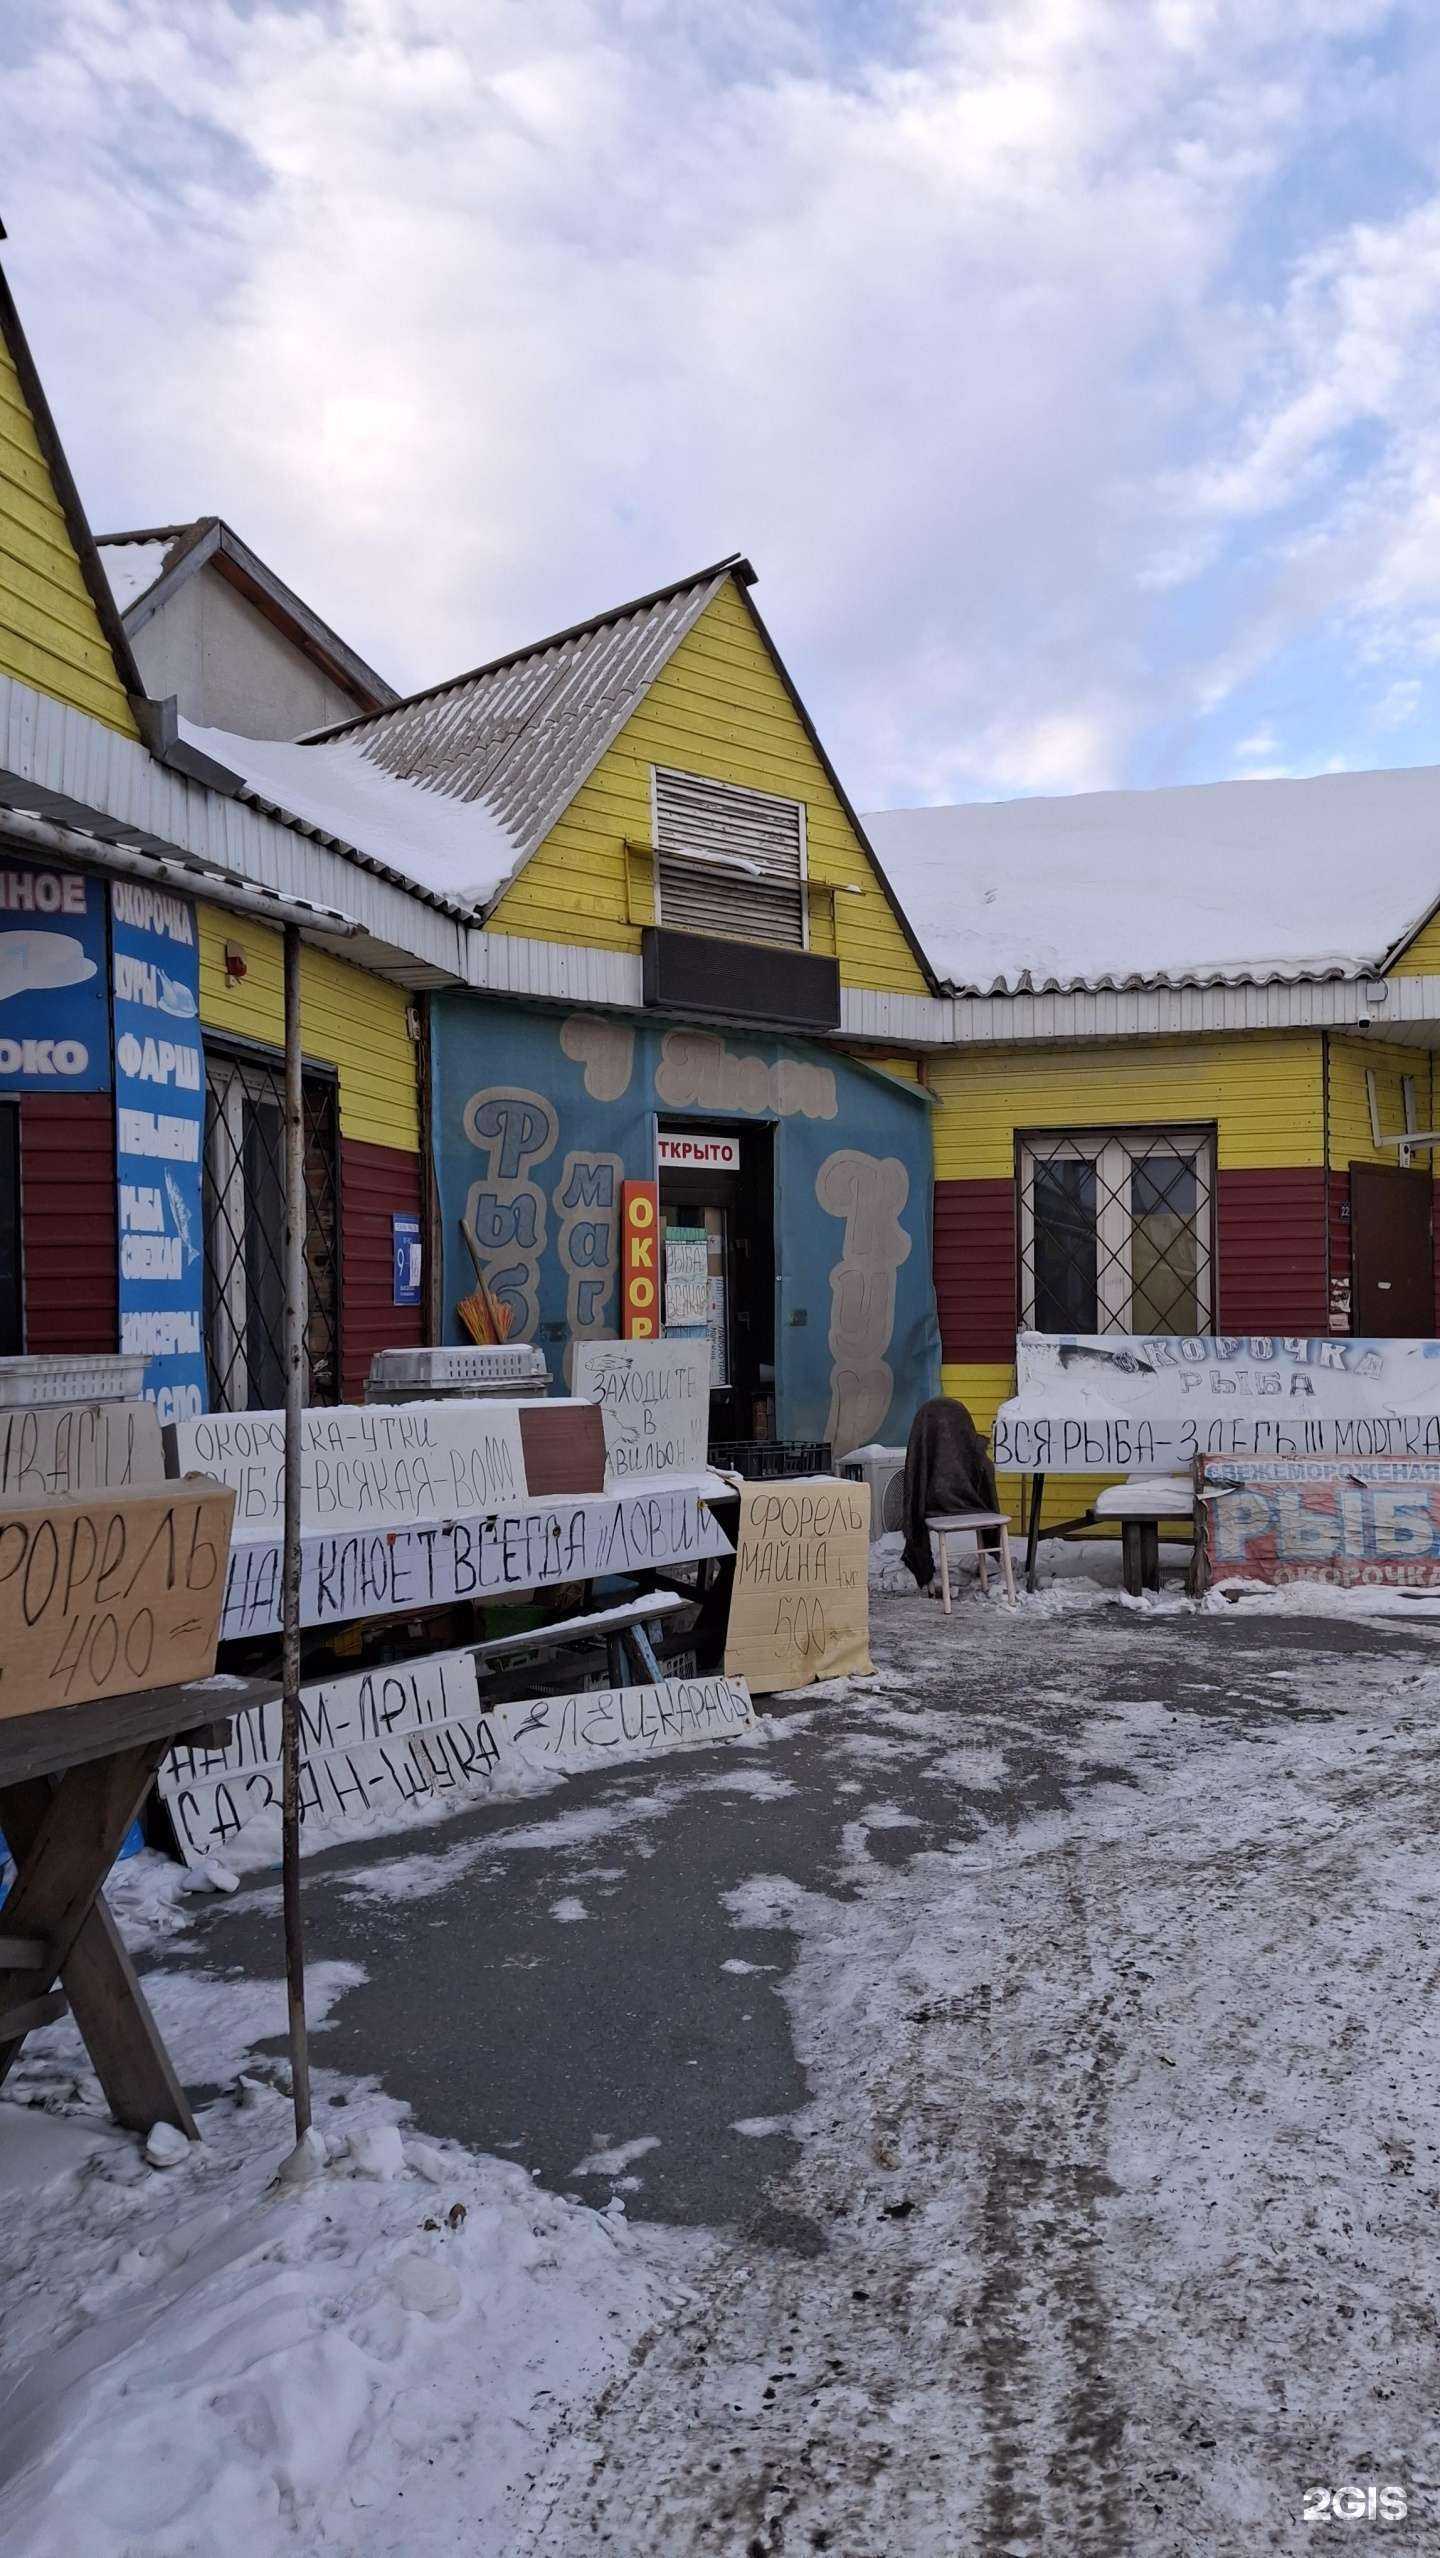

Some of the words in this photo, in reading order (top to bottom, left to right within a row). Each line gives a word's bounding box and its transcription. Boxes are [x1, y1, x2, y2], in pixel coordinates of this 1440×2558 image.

[0, 871, 87, 914] НОЕ
[112, 881, 194, 946] ОКОРОЧКА
[118, 1032, 200, 1091] ФАРШ
[592, 1366, 697, 1405] ЗАХОДИТЕ
[1179, 1368, 1316, 1397] РЫБА
[643, 1408, 657, 1435] В
[750, 1493, 863, 1540] ФОРЕЛЬ
[738, 1540, 829, 1585] МАЙНА
